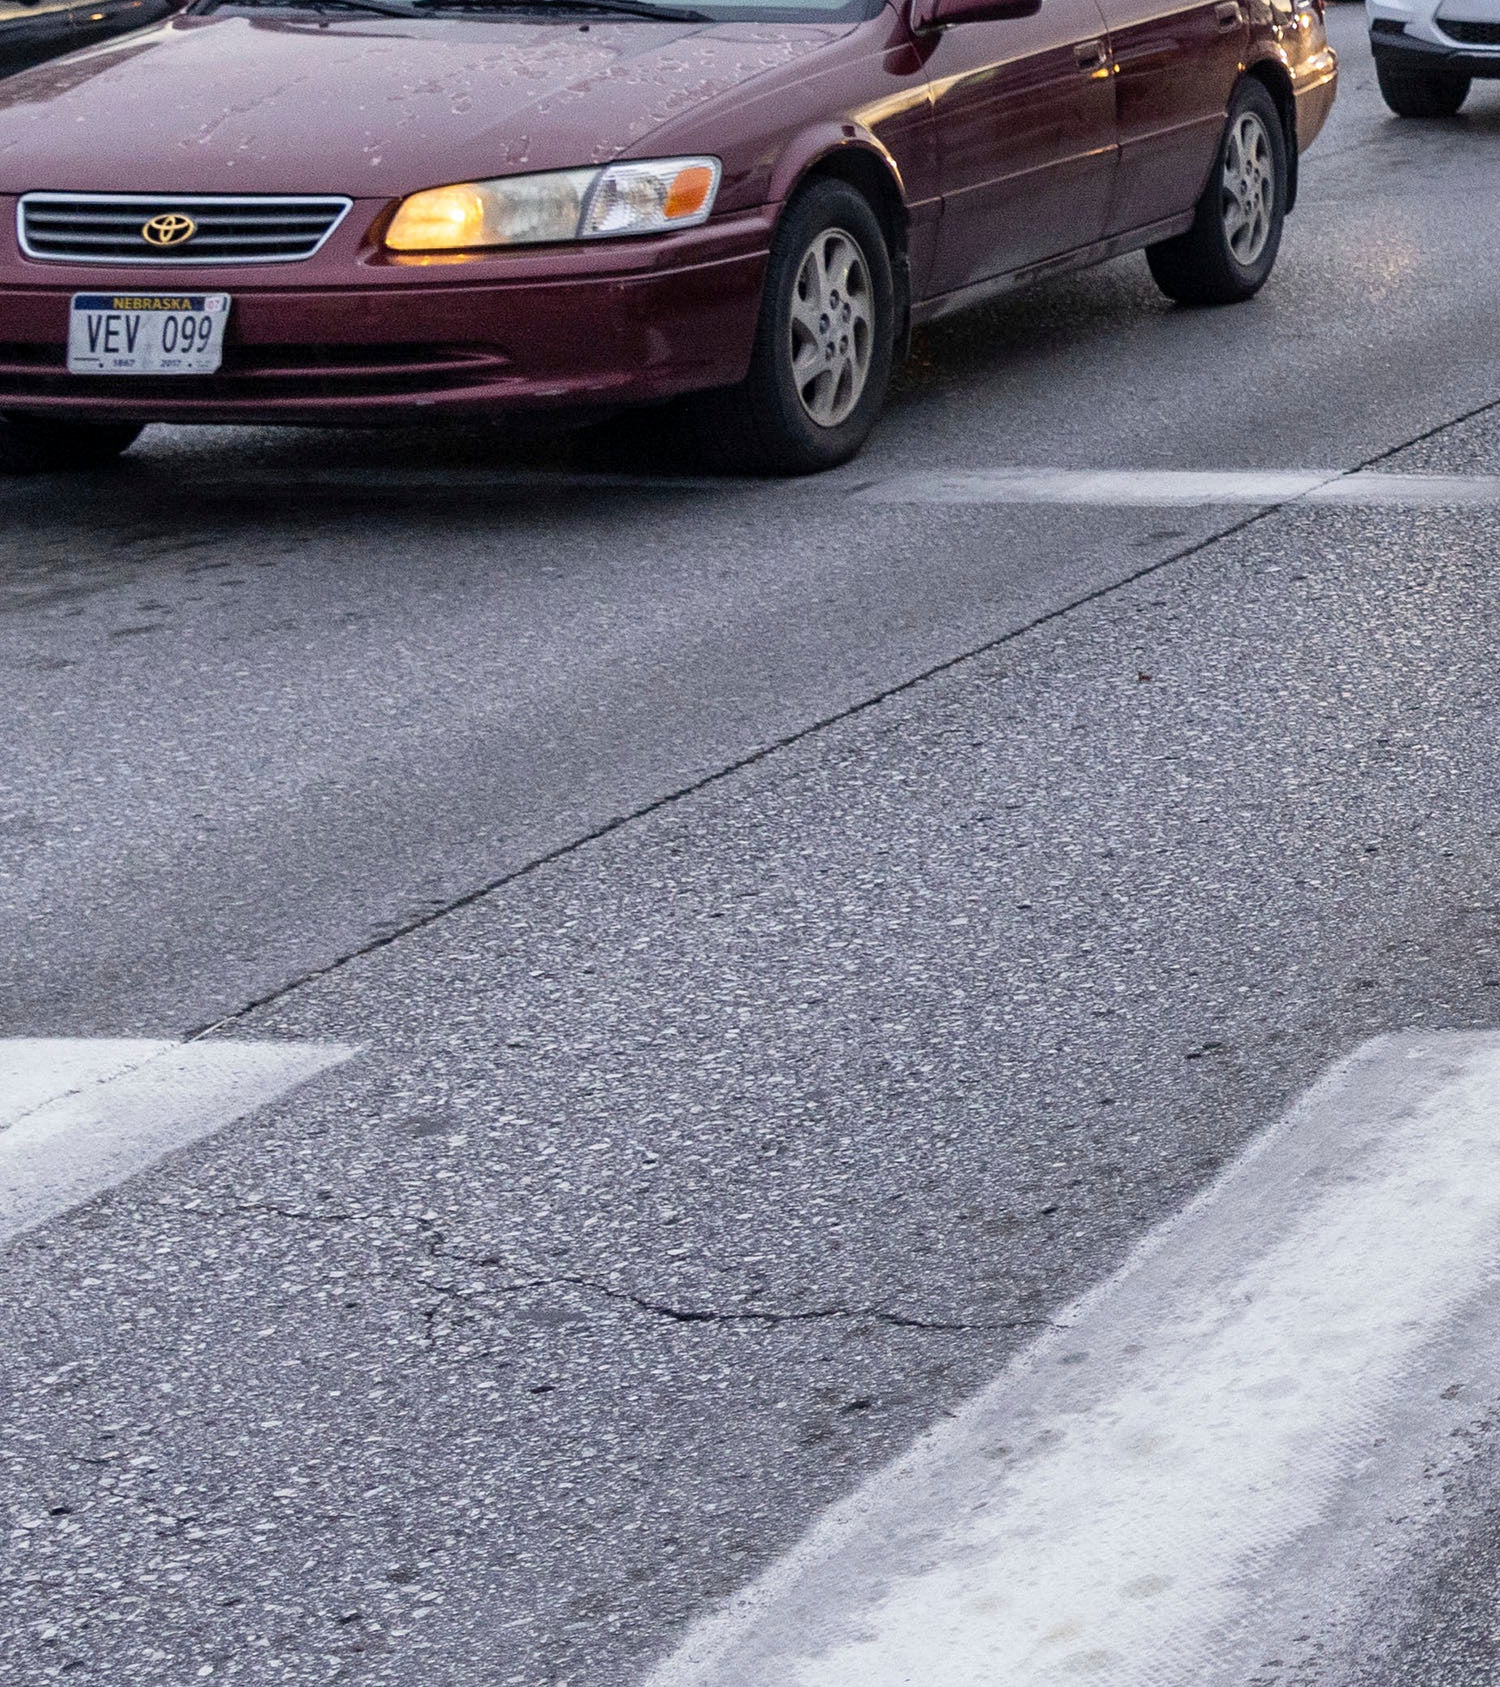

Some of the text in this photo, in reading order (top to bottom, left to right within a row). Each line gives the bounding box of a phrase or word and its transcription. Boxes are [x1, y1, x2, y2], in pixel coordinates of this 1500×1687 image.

[113, 297, 192, 310] NEBRASKA
[87, 314, 213, 354] VEV 099
